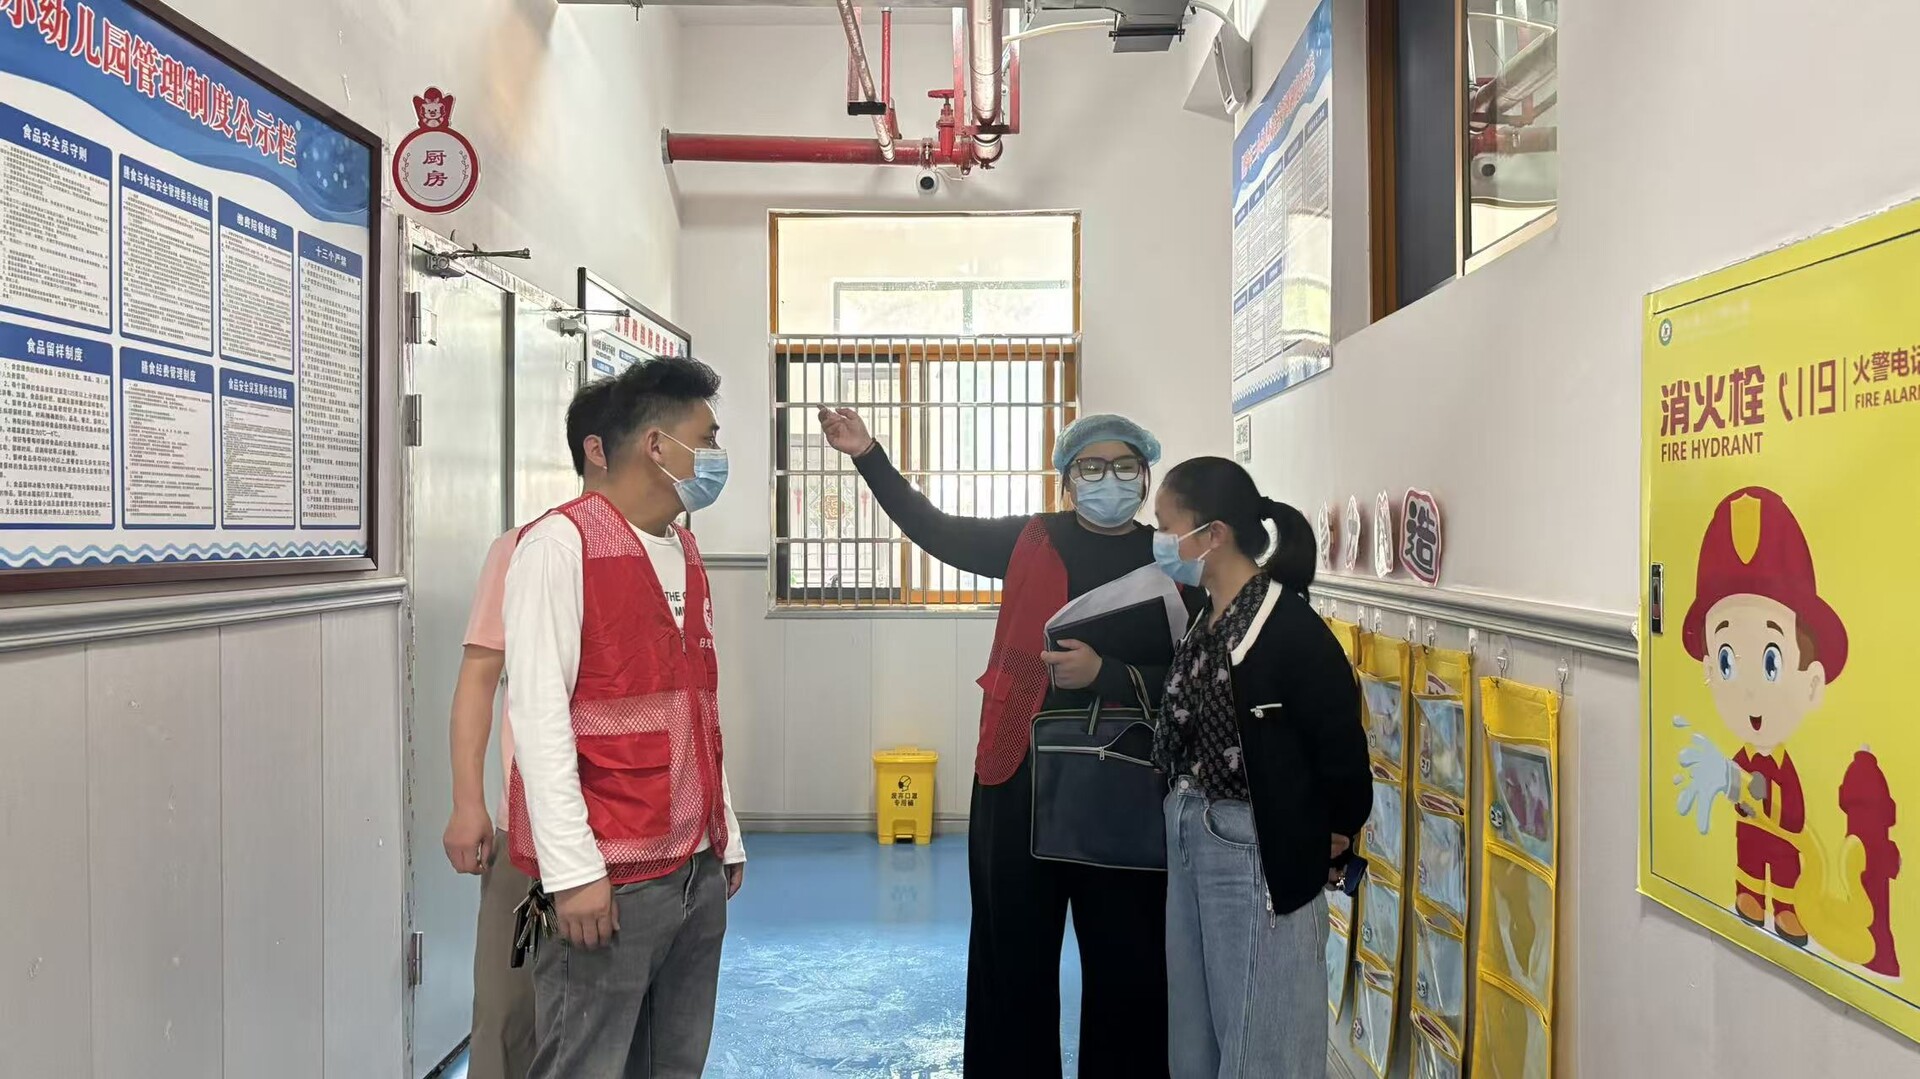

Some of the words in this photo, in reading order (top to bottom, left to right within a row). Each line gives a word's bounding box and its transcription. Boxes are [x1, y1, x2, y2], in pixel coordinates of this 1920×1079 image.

[22, 123, 88, 162] 食品安全员守则
[422, 149, 449, 187] 厨房
[26, 337, 83, 362] 食品留样制度
[141, 360, 197, 383] 膳食经费管理制度
[1660, 364, 1765, 437] 消火栓
[1798, 359, 1837, 418] 119
[1854, 391, 1880, 410] FIRE
[1661, 441, 1688, 463] FIRE
[1691, 431, 1764, 460] HYDRANT
[664, 591, 681, 602] THE
